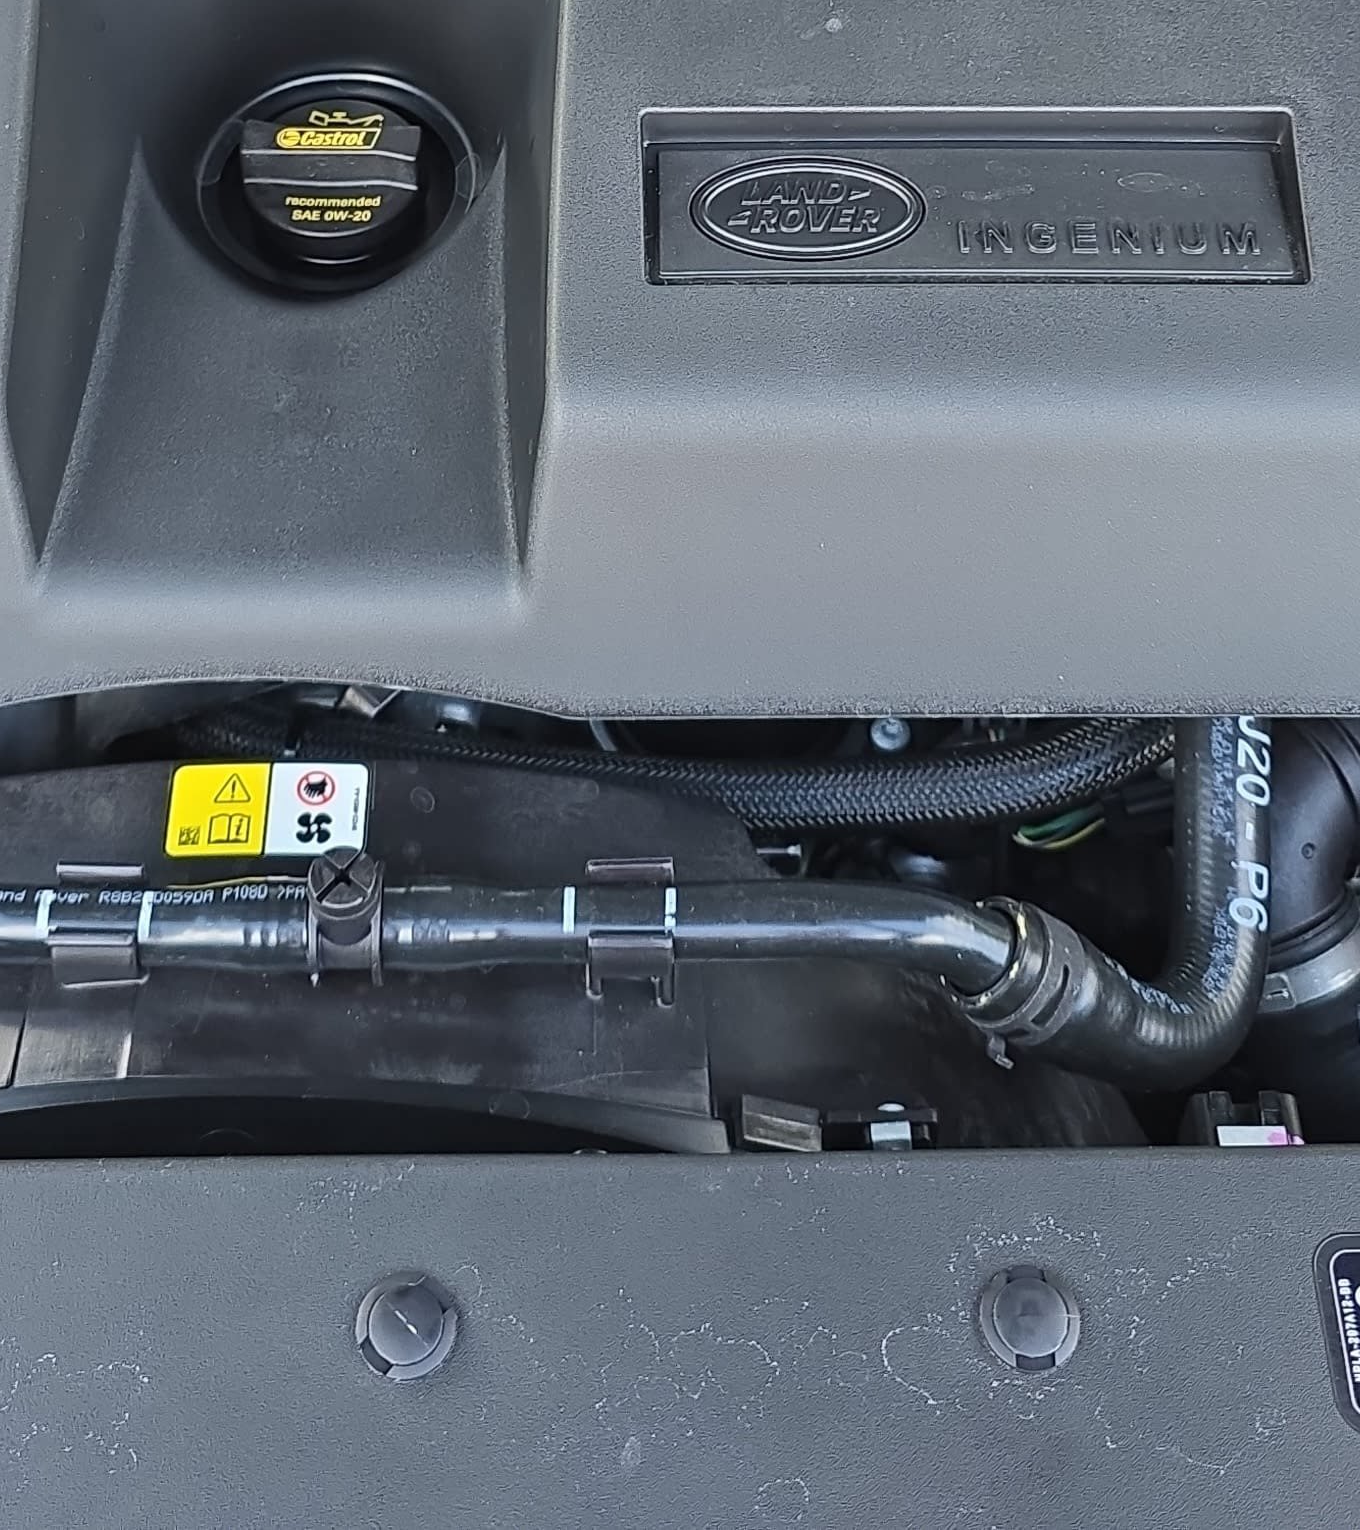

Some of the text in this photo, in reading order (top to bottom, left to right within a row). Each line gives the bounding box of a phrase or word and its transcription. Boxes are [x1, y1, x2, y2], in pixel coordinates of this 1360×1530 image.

[299, 129, 365, 148] Castrol
[285, 196, 382, 208] recommended
[741, 179, 849, 206] LAND
[291, 209, 372, 222] SAE 0W-20
[751, 206, 882, 233] ROVER
[956, 220, 1262, 257] INGENIUM
[1228, 860, 1270, 933] P6
